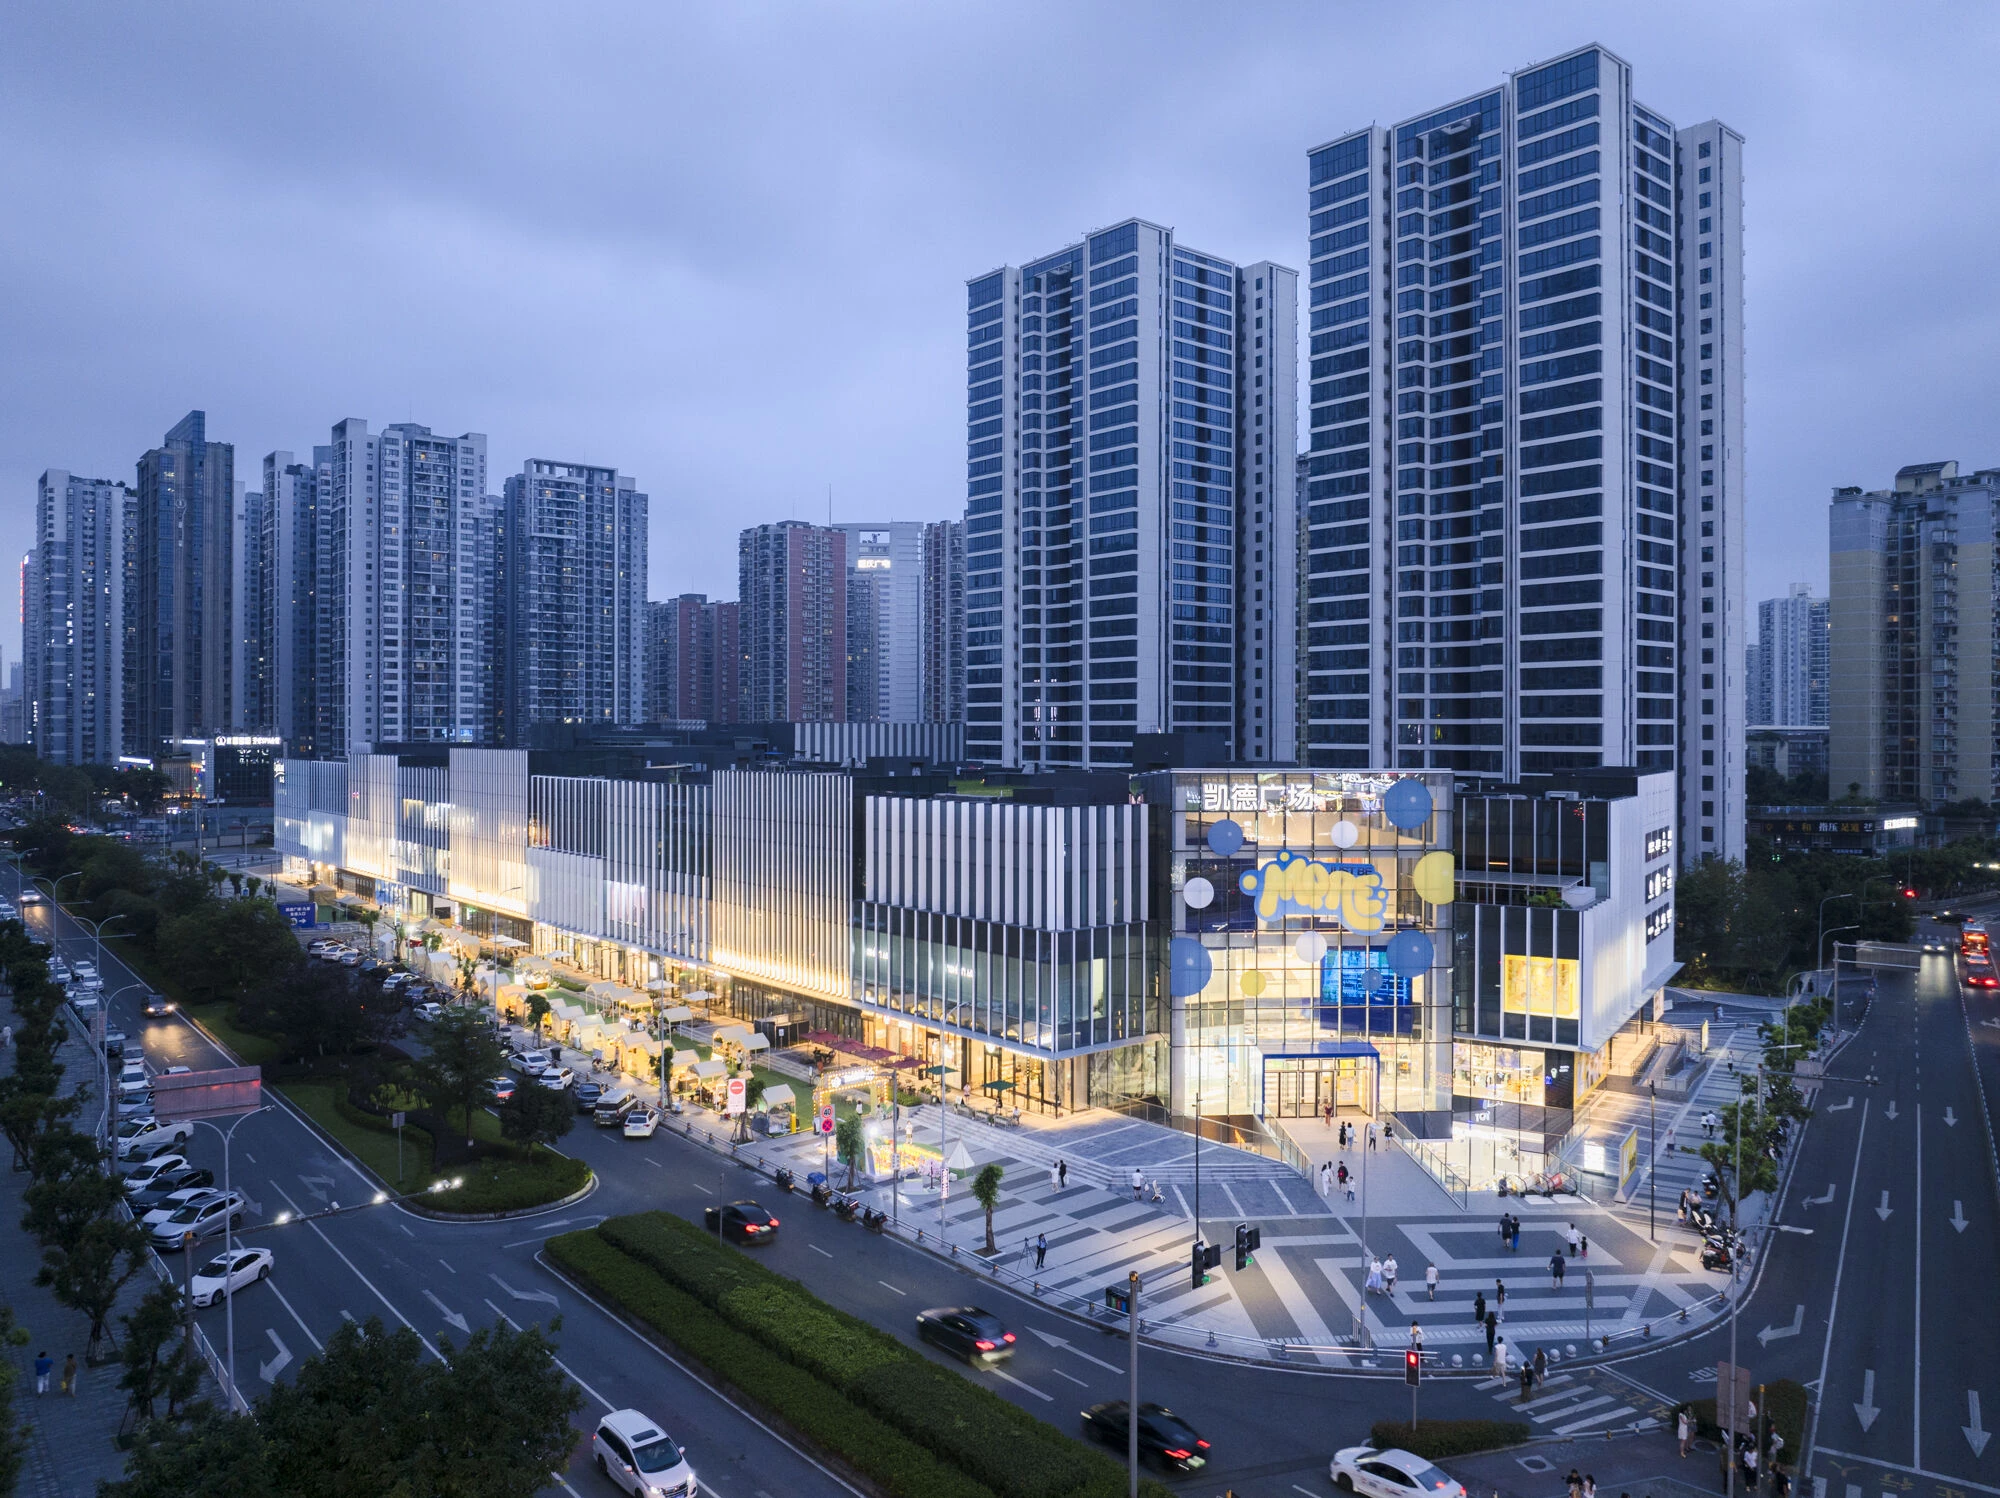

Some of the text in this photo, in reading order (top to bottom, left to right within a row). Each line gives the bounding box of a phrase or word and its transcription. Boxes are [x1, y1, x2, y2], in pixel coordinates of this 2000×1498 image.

[1203, 783, 1314, 811] 凯德广场
[1357, 867, 1373, 876] BE
